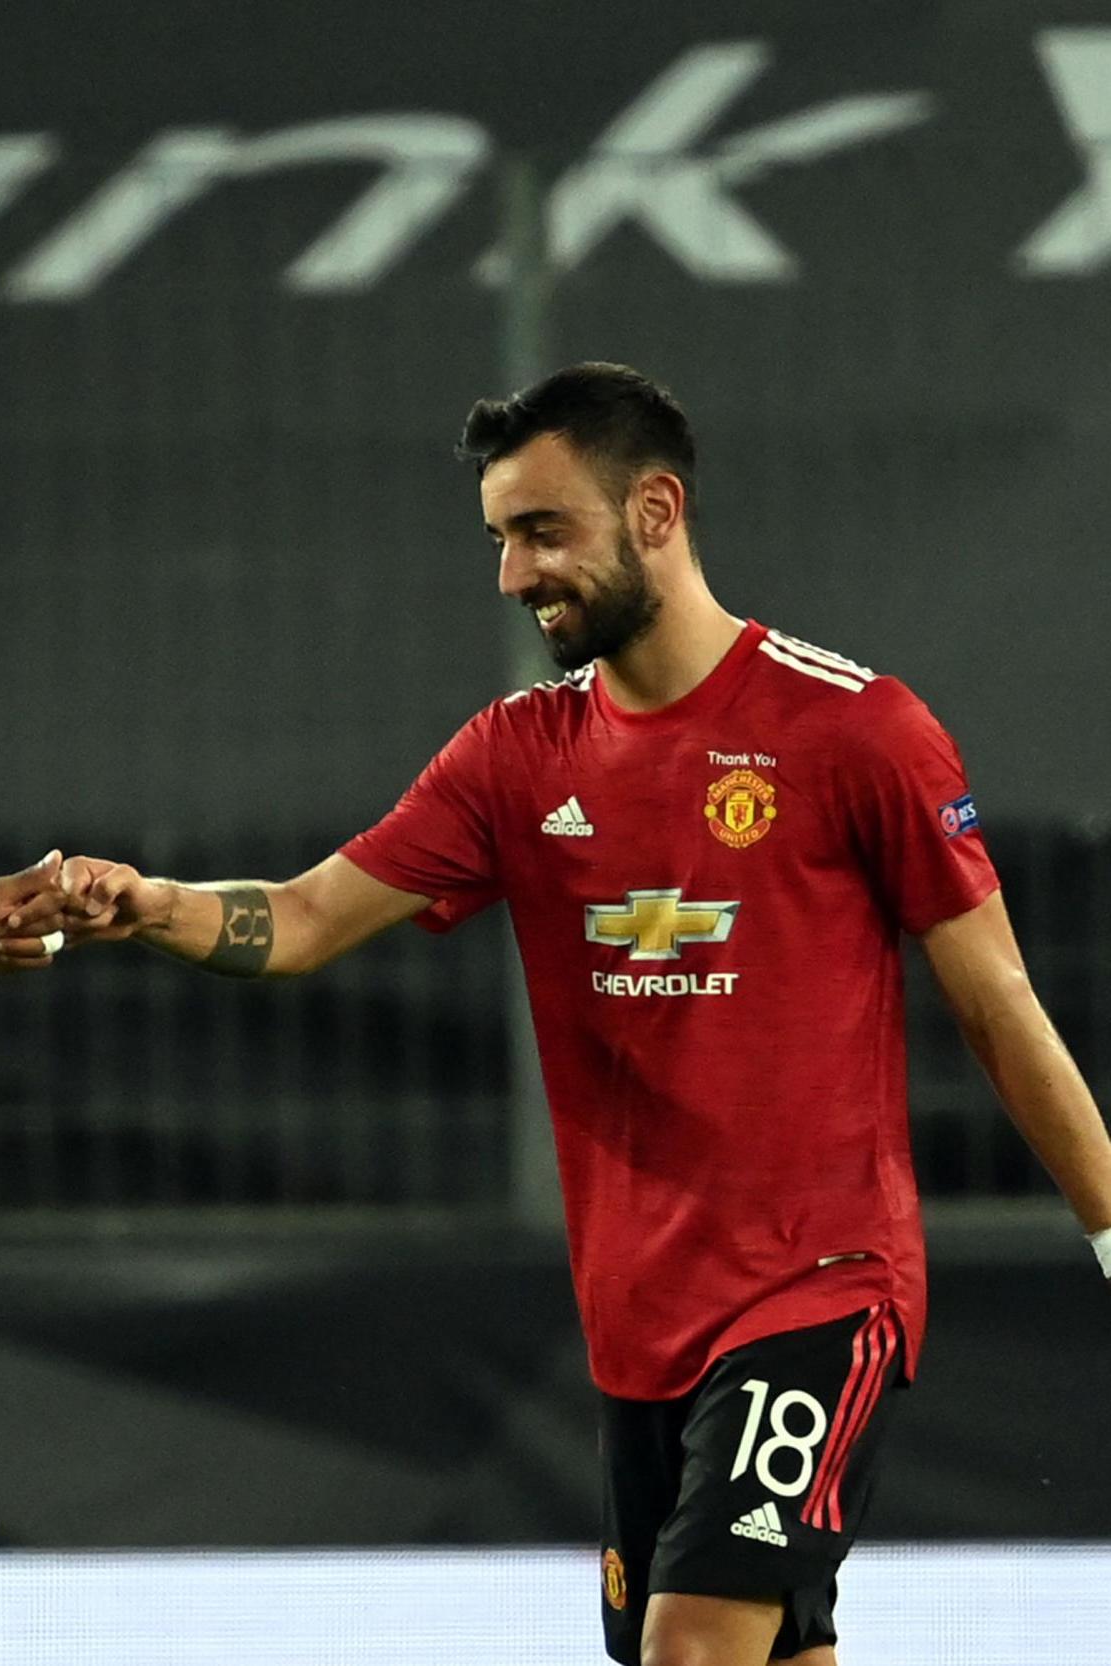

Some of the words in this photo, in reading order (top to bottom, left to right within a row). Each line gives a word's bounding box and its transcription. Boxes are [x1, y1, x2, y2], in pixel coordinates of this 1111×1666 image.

[707, 750, 750, 766] Thank
[753, 753, 777, 767] You
[541, 818, 594, 837] adidas
[592, 970, 739, 997] CHEVROLET
[729, 1378, 828, 1498] 18
[730, 1520, 789, 1548] adidas
